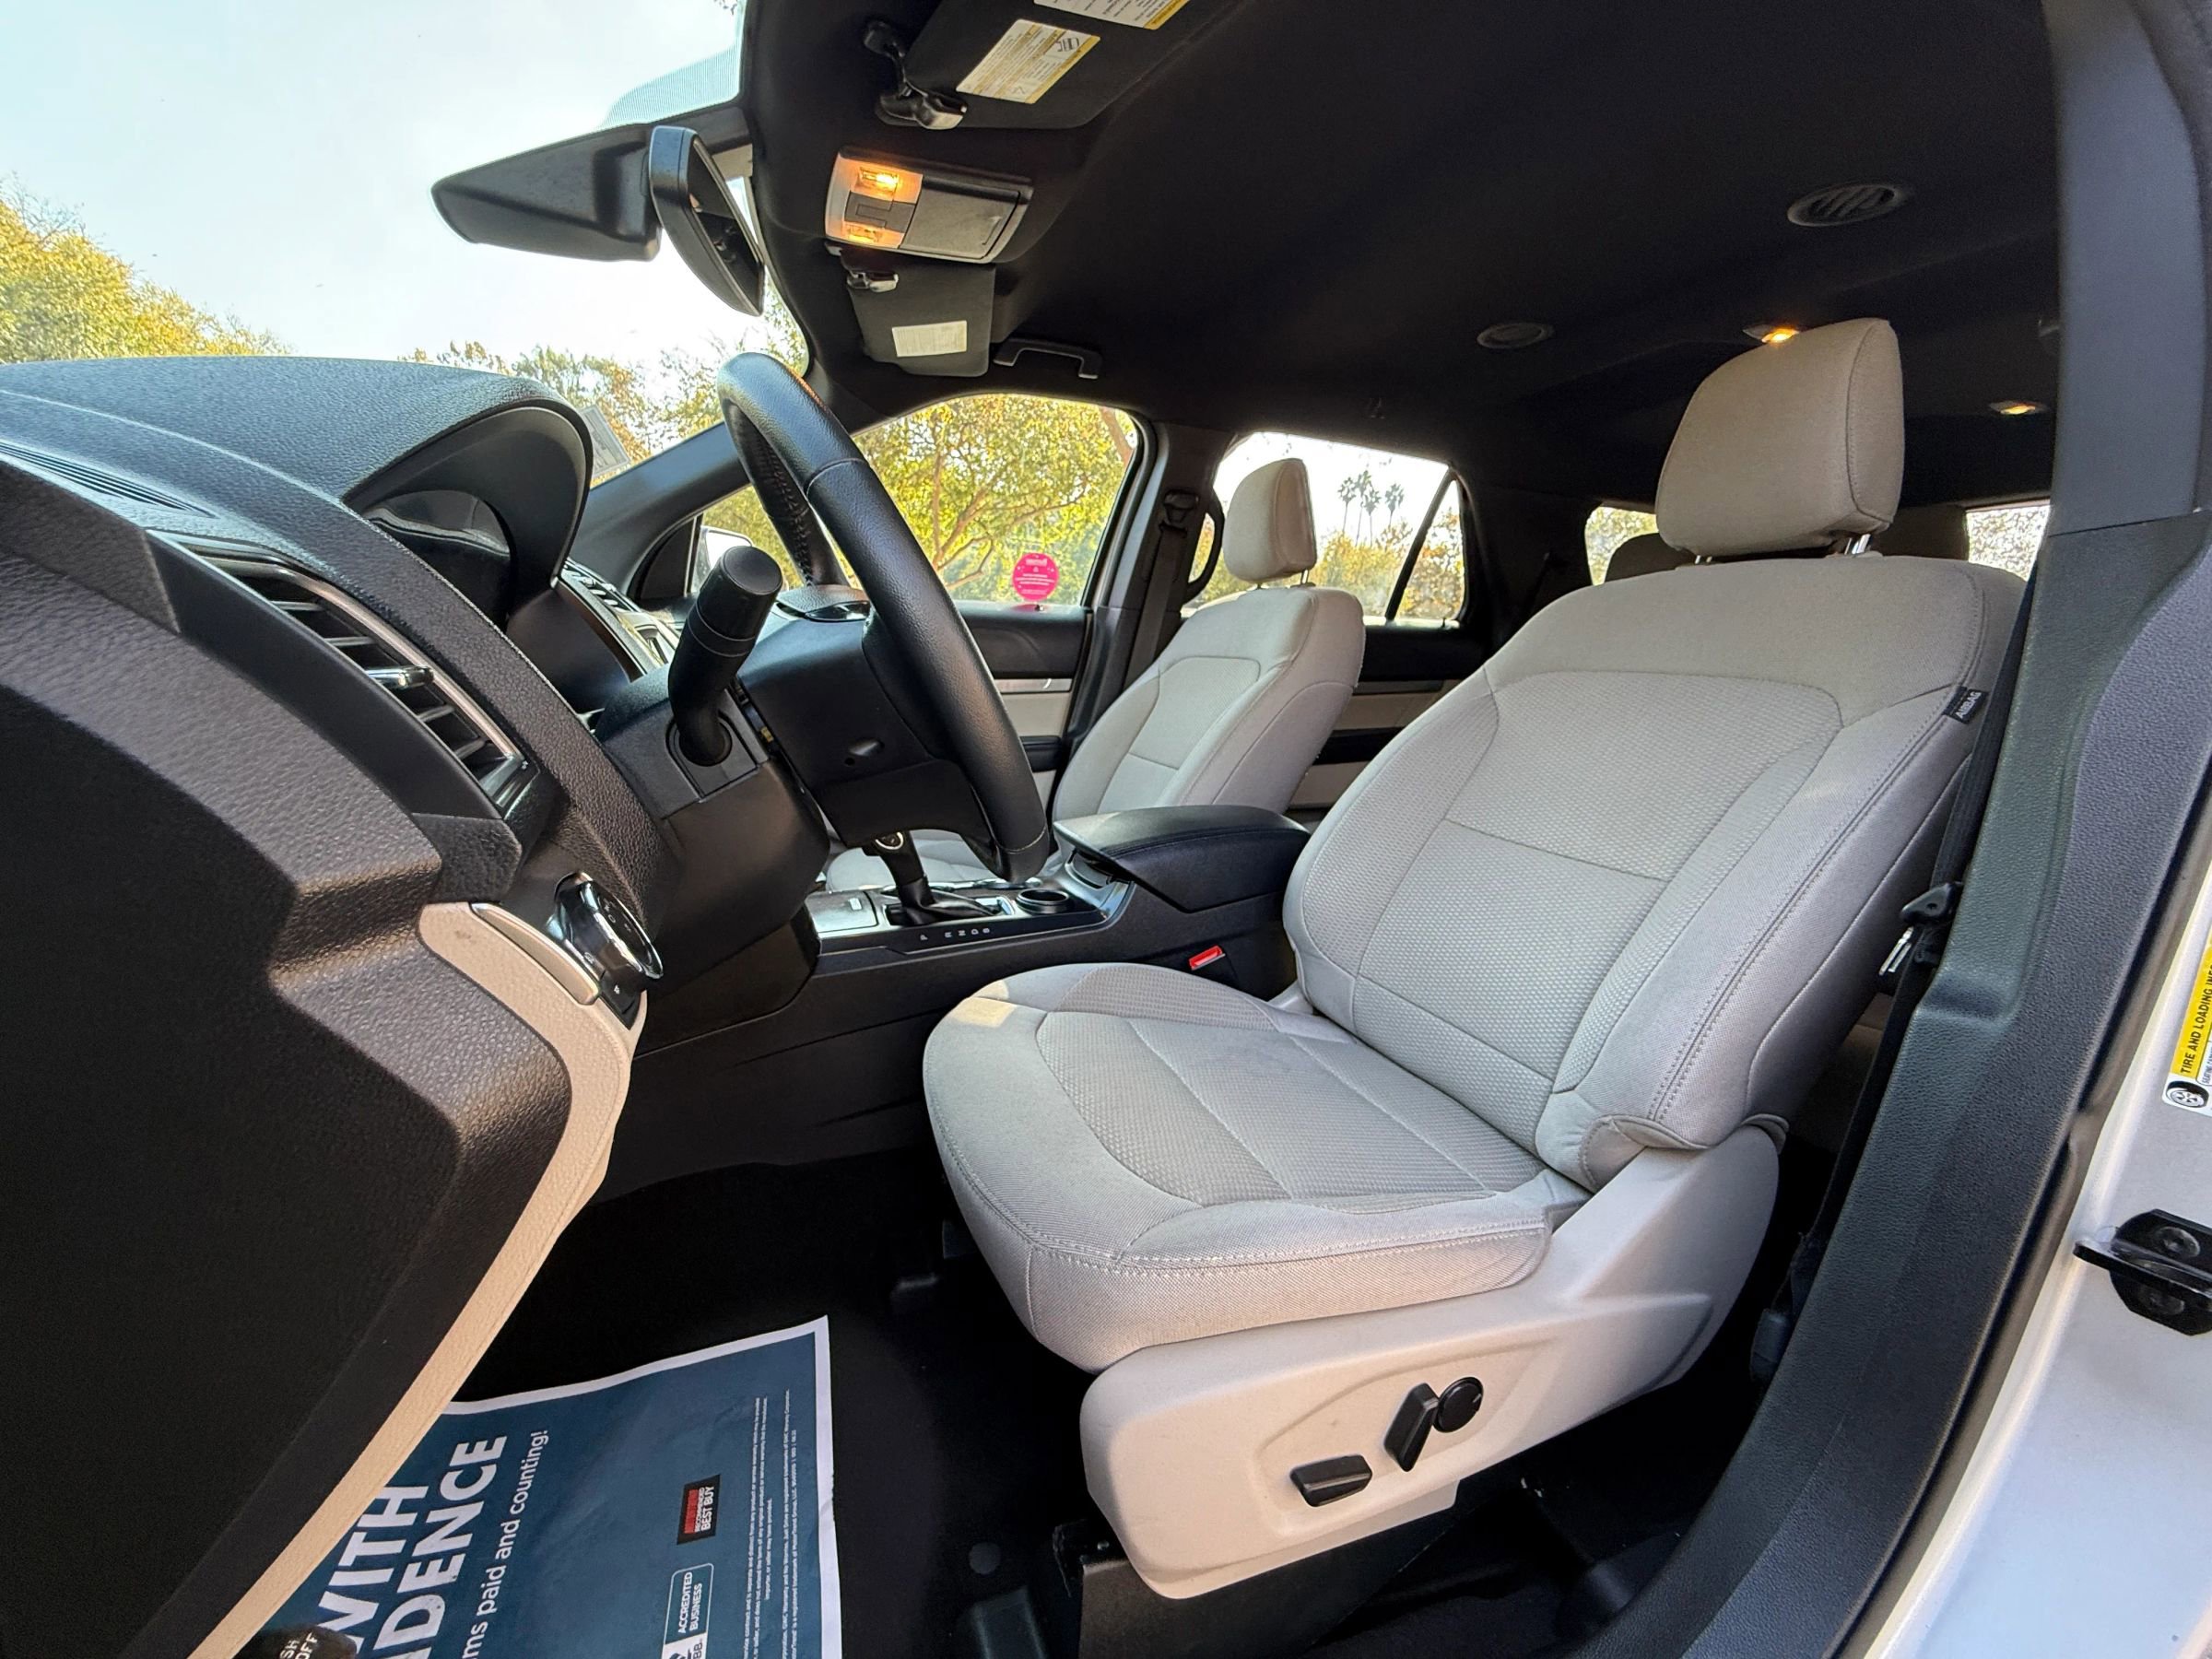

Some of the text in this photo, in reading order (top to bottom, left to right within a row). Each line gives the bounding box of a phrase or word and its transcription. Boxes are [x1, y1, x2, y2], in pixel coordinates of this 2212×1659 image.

[1955, 691, 1982, 719] AIRBAG
[2193, 988, 2212, 1030] LOADING
[2180, 1053, 2195, 1074] TIRE
[2187, 1031, 2201, 1052] AND
[476, 1565, 507, 1617] paid
[495, 1519, 520, 1560] and
[510, 1430, 548, 1515] counting!
[700, 1486, 714, 1531] BEST BUY
[317, 1486, 429, 1654] WITH
[678, 1571, 692, 1633] ACCREDITED
[689, 1583, 702, 1631] BUSINESS
